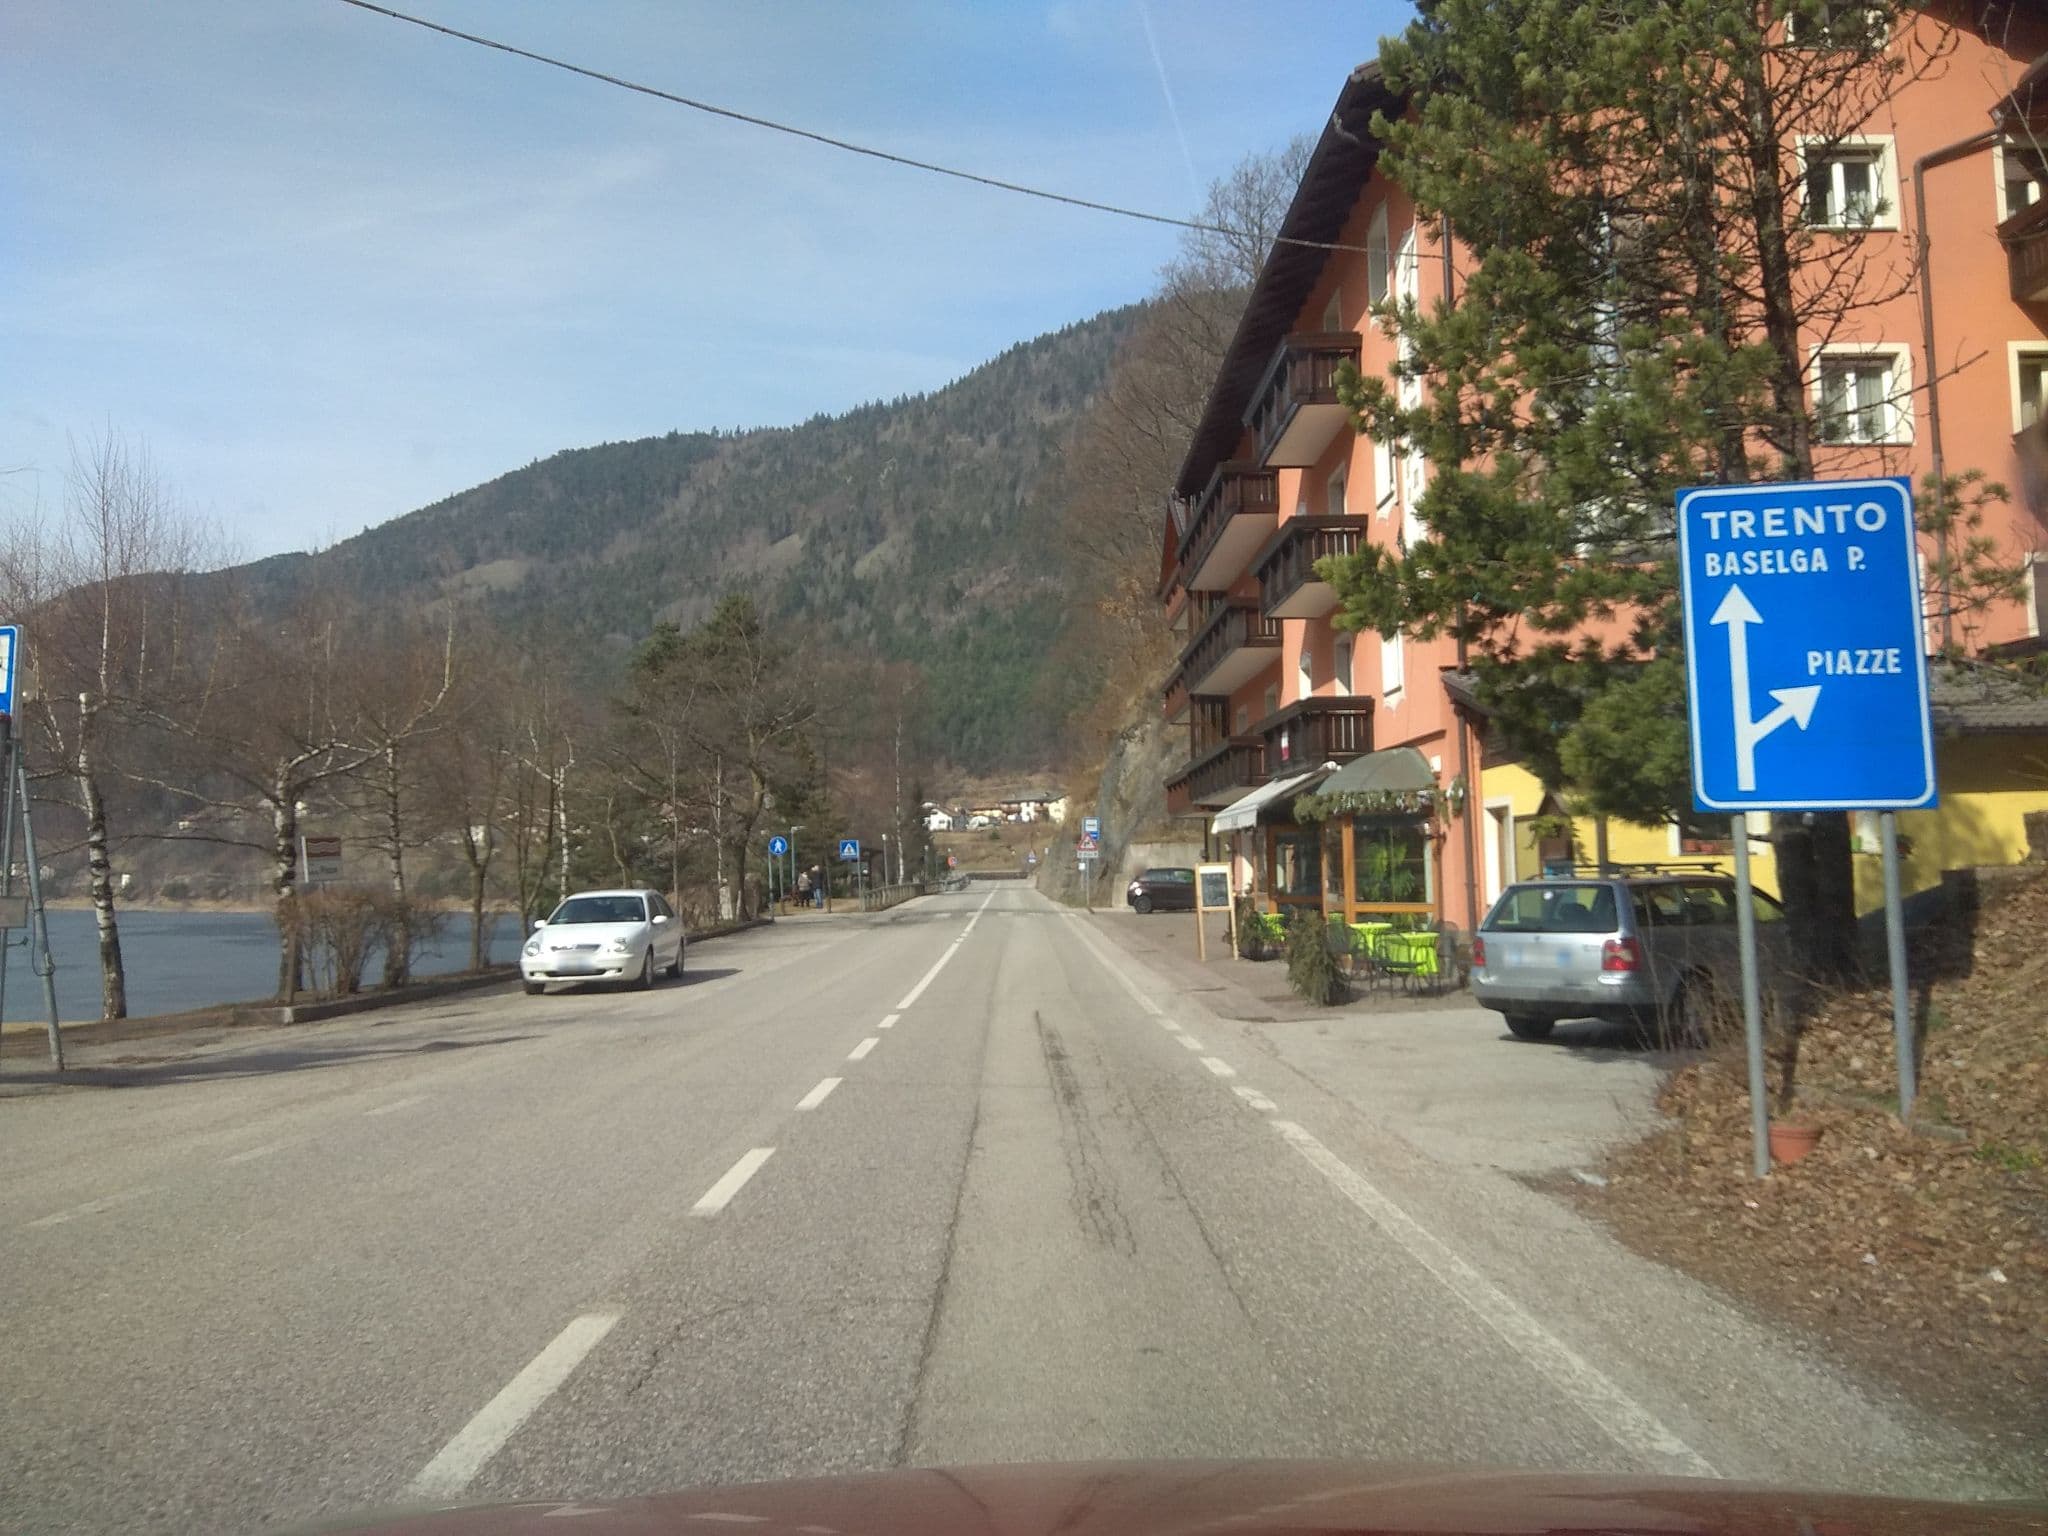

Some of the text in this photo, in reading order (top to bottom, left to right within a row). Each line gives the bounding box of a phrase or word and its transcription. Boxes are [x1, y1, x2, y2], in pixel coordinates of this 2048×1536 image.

[1701, 502, 1886, 540] TRENTO
[1706, 546, 1866, 577] BASELGA P.
[1807, 648, 1902, 676] PIAZZE
